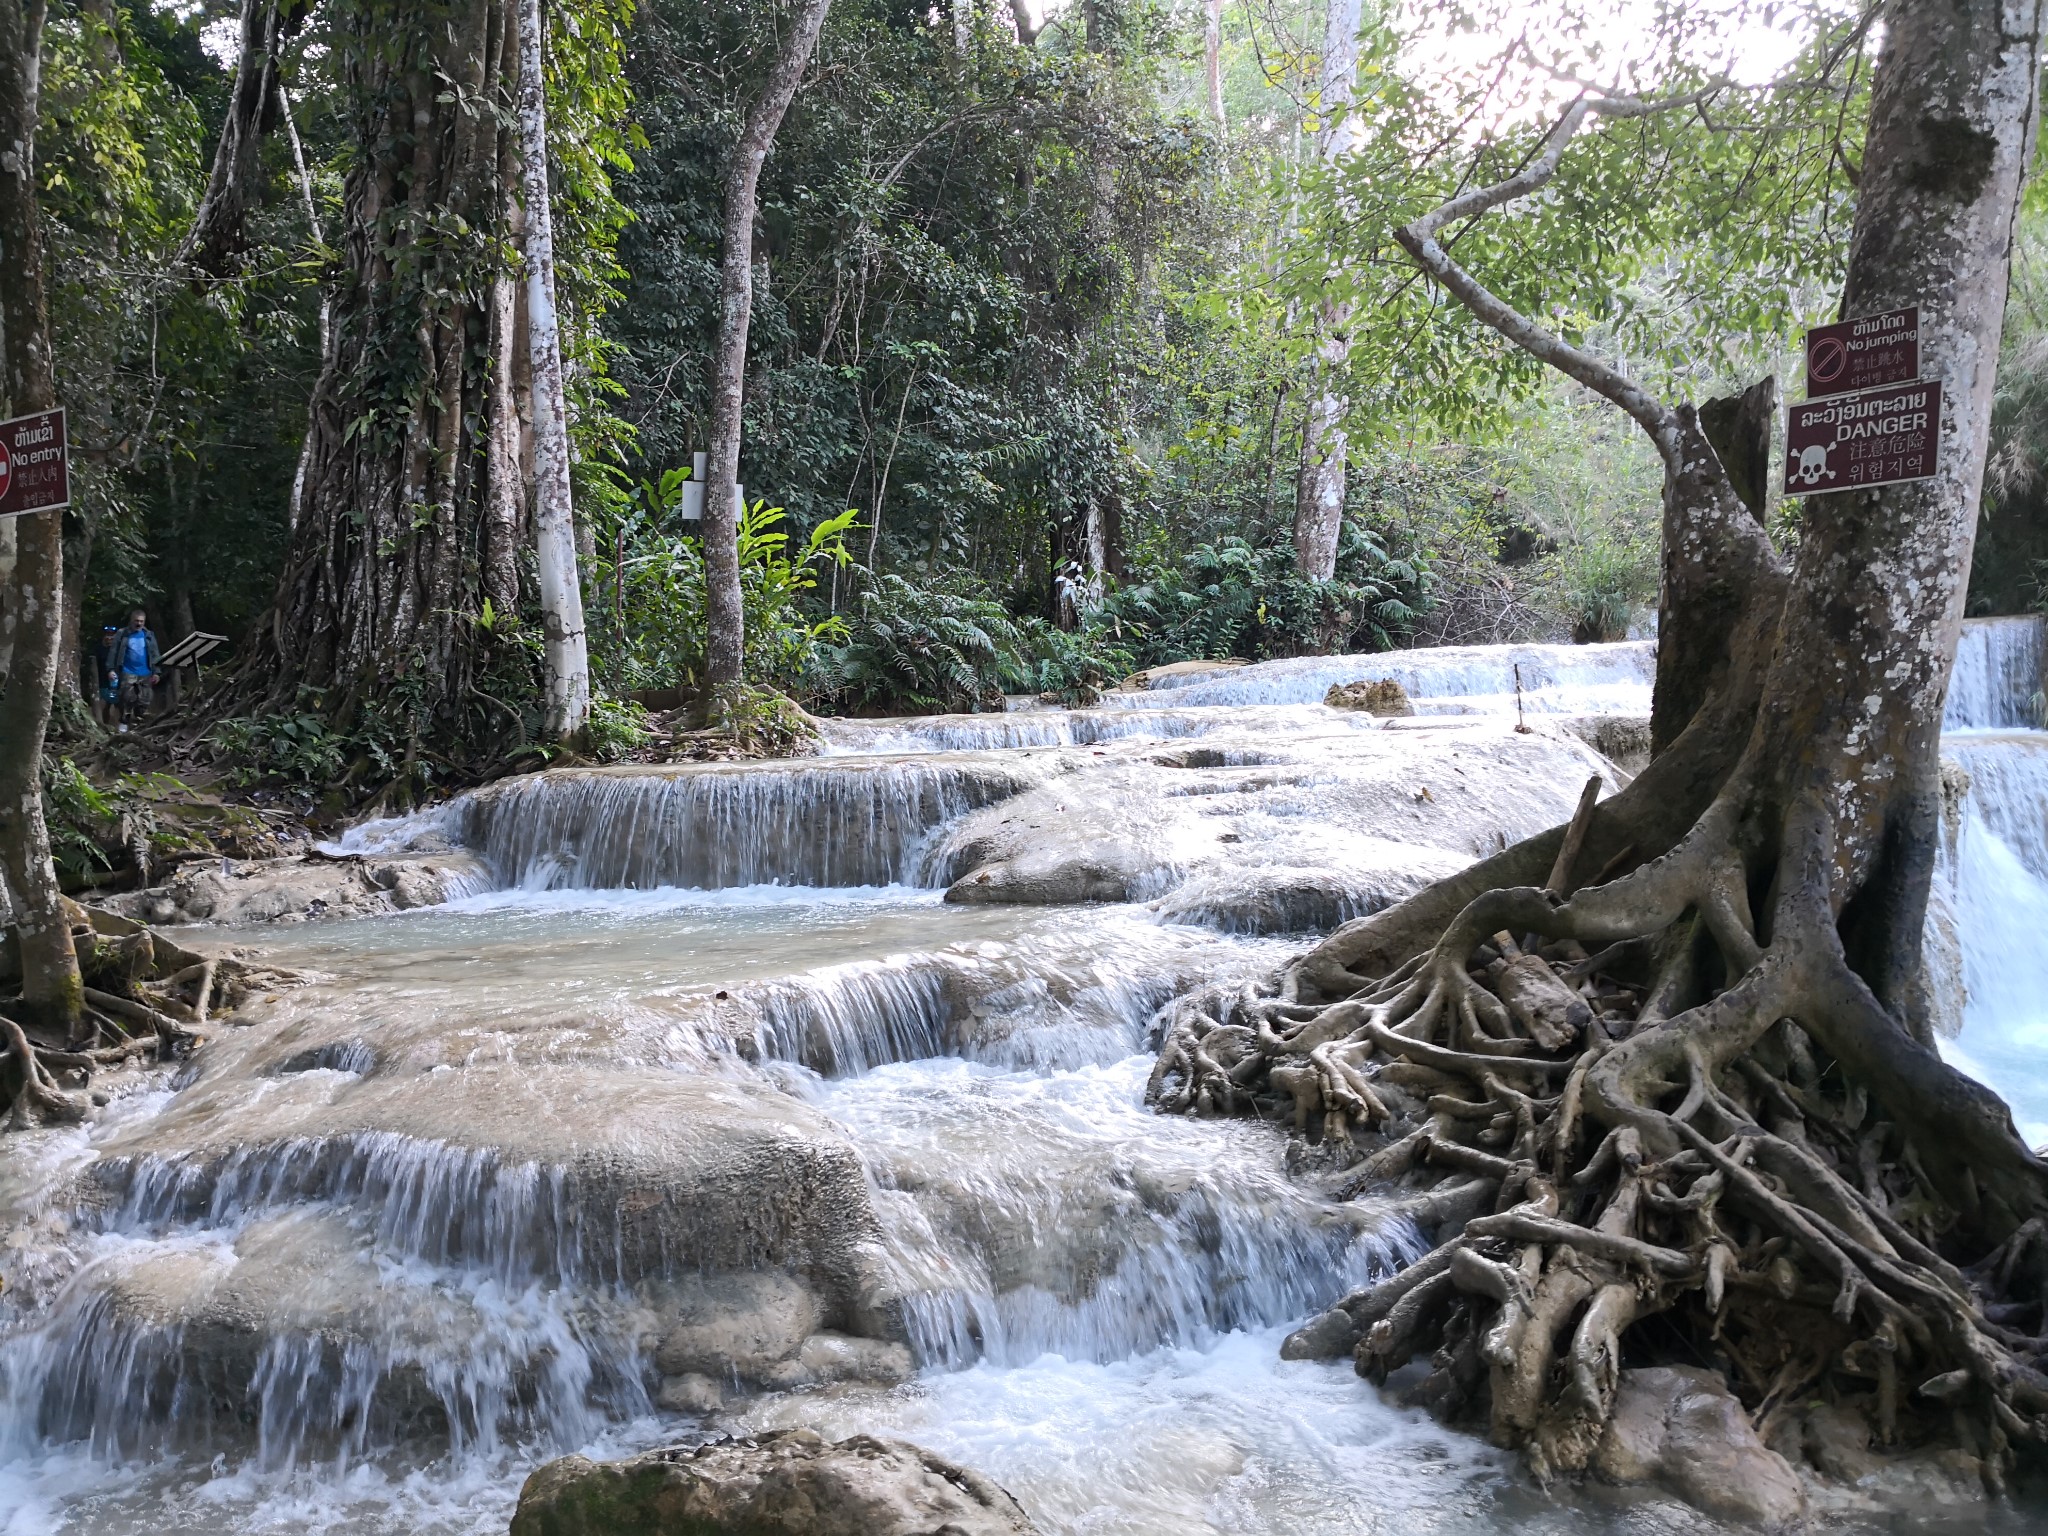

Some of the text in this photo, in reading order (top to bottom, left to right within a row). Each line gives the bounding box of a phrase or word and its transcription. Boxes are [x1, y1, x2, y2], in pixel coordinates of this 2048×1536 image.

[1846, 329, 1917, 352] No jumping
[1853, 349, 1904, 372] 禁止跳水
[1837, 412, 1928, 442] DANGER
[12, 446, 62, 467] No entry
[1850, 431, 1926, 461] 注意危险
